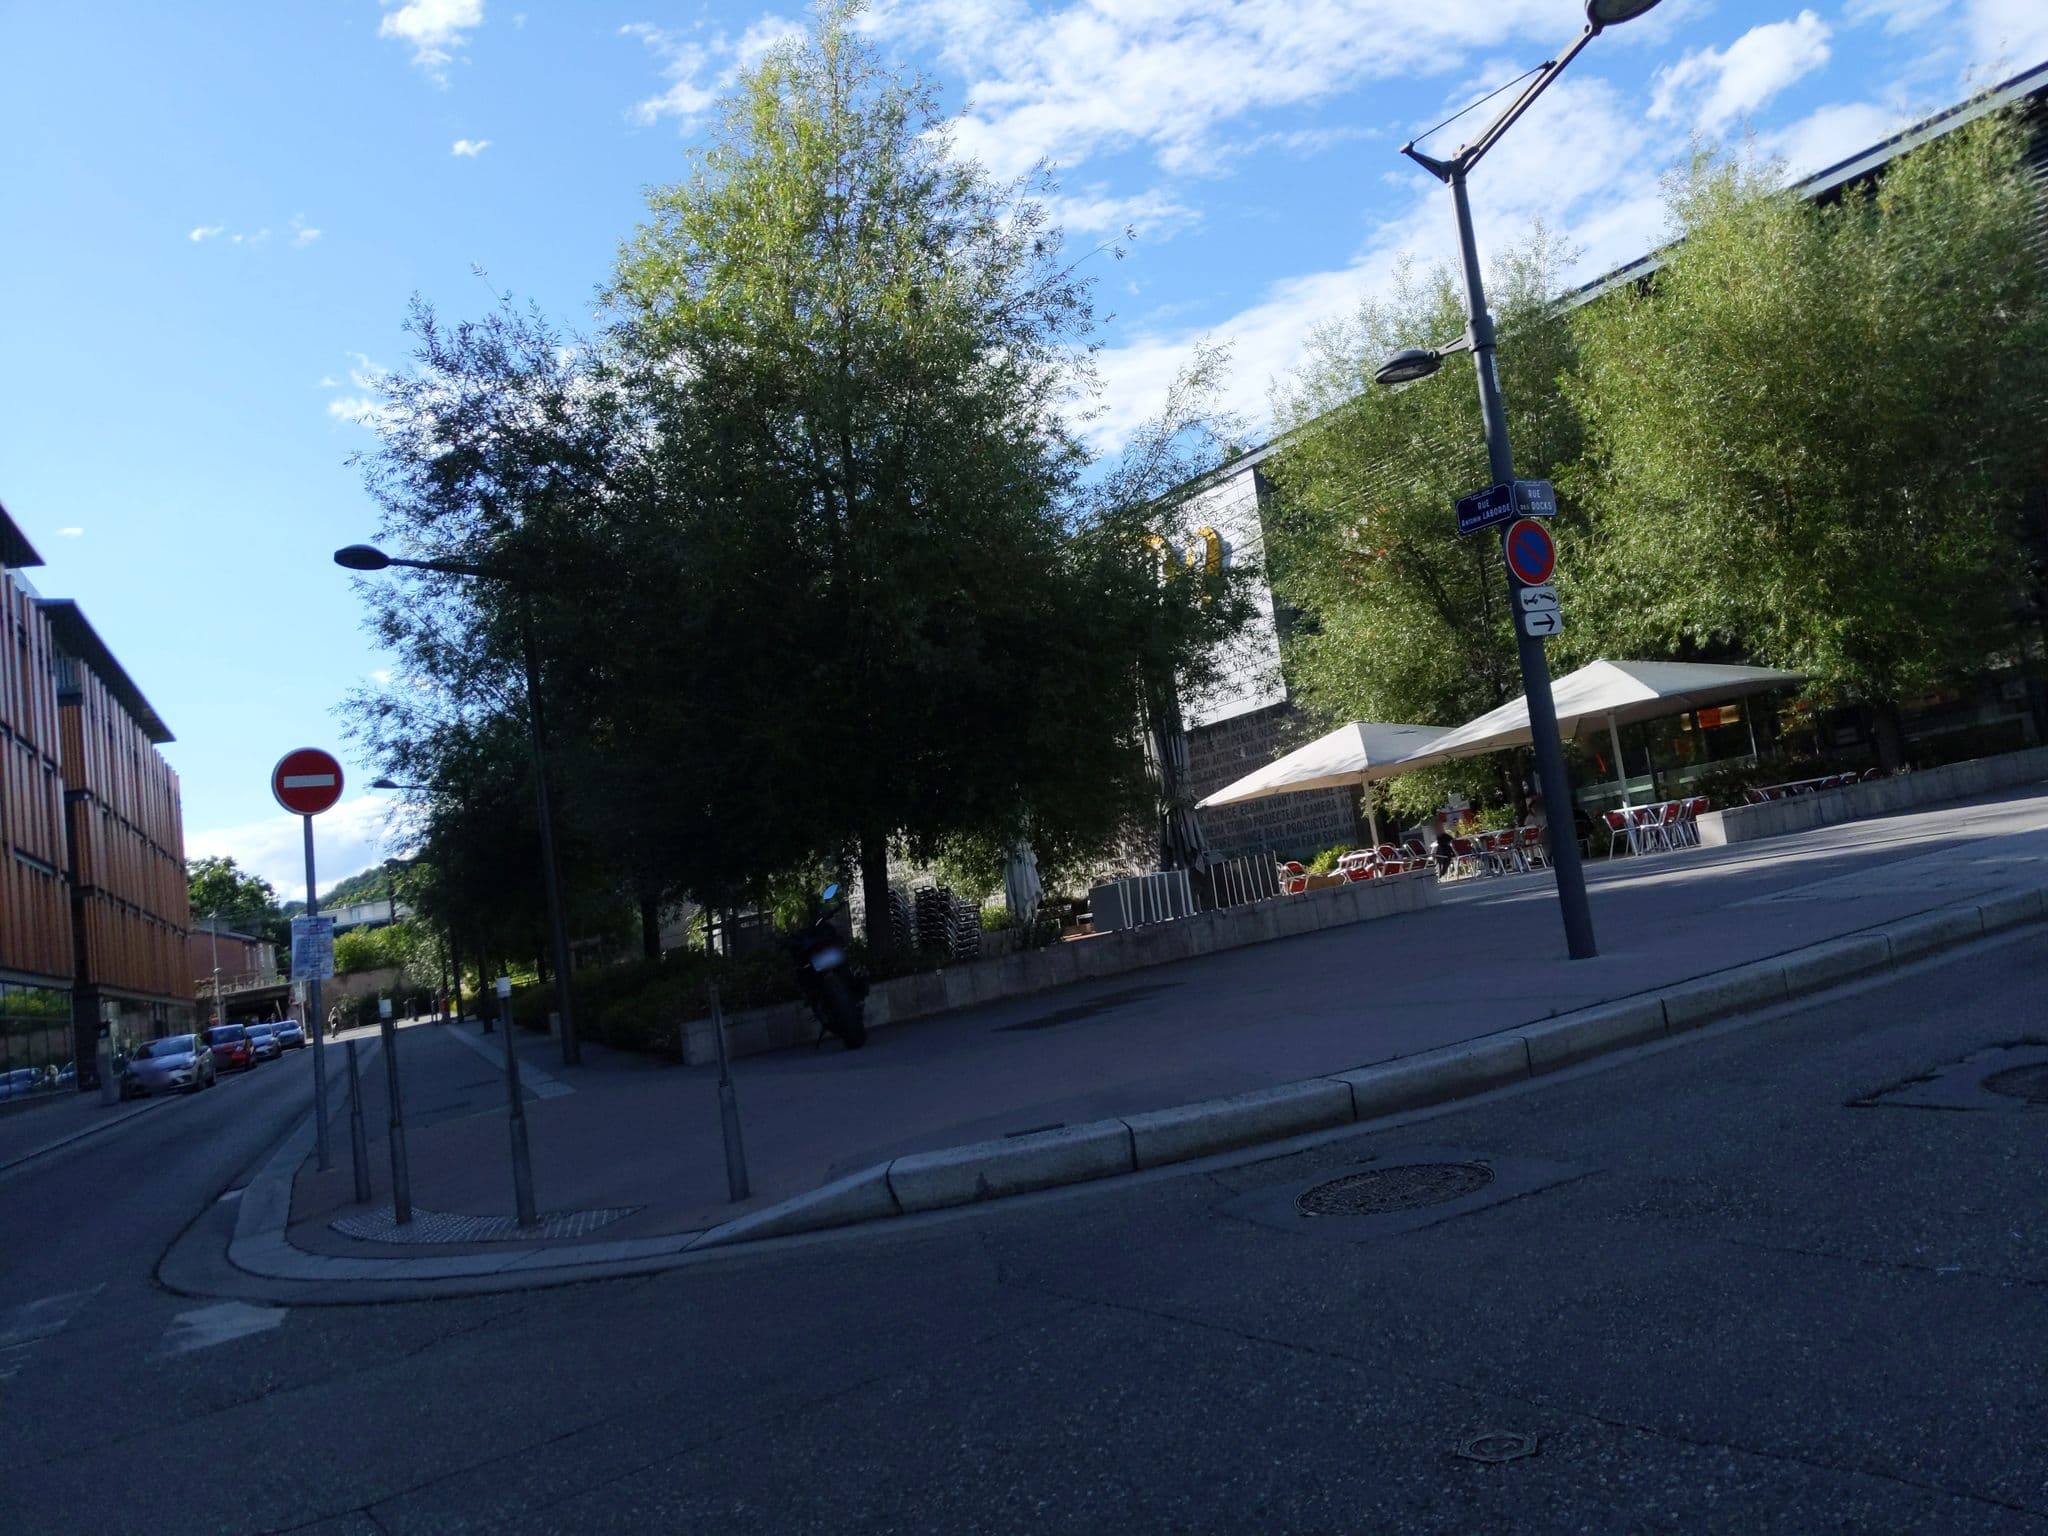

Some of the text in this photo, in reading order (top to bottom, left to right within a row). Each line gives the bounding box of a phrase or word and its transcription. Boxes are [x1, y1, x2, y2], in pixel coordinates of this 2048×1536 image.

[1527, 488, 1541, 499] RUE
[1477, 498, 1490, 511] RUE
[1530, 501, 1553, 511] DOCKS
[1482, 502, 1511, 520] LABORDE
